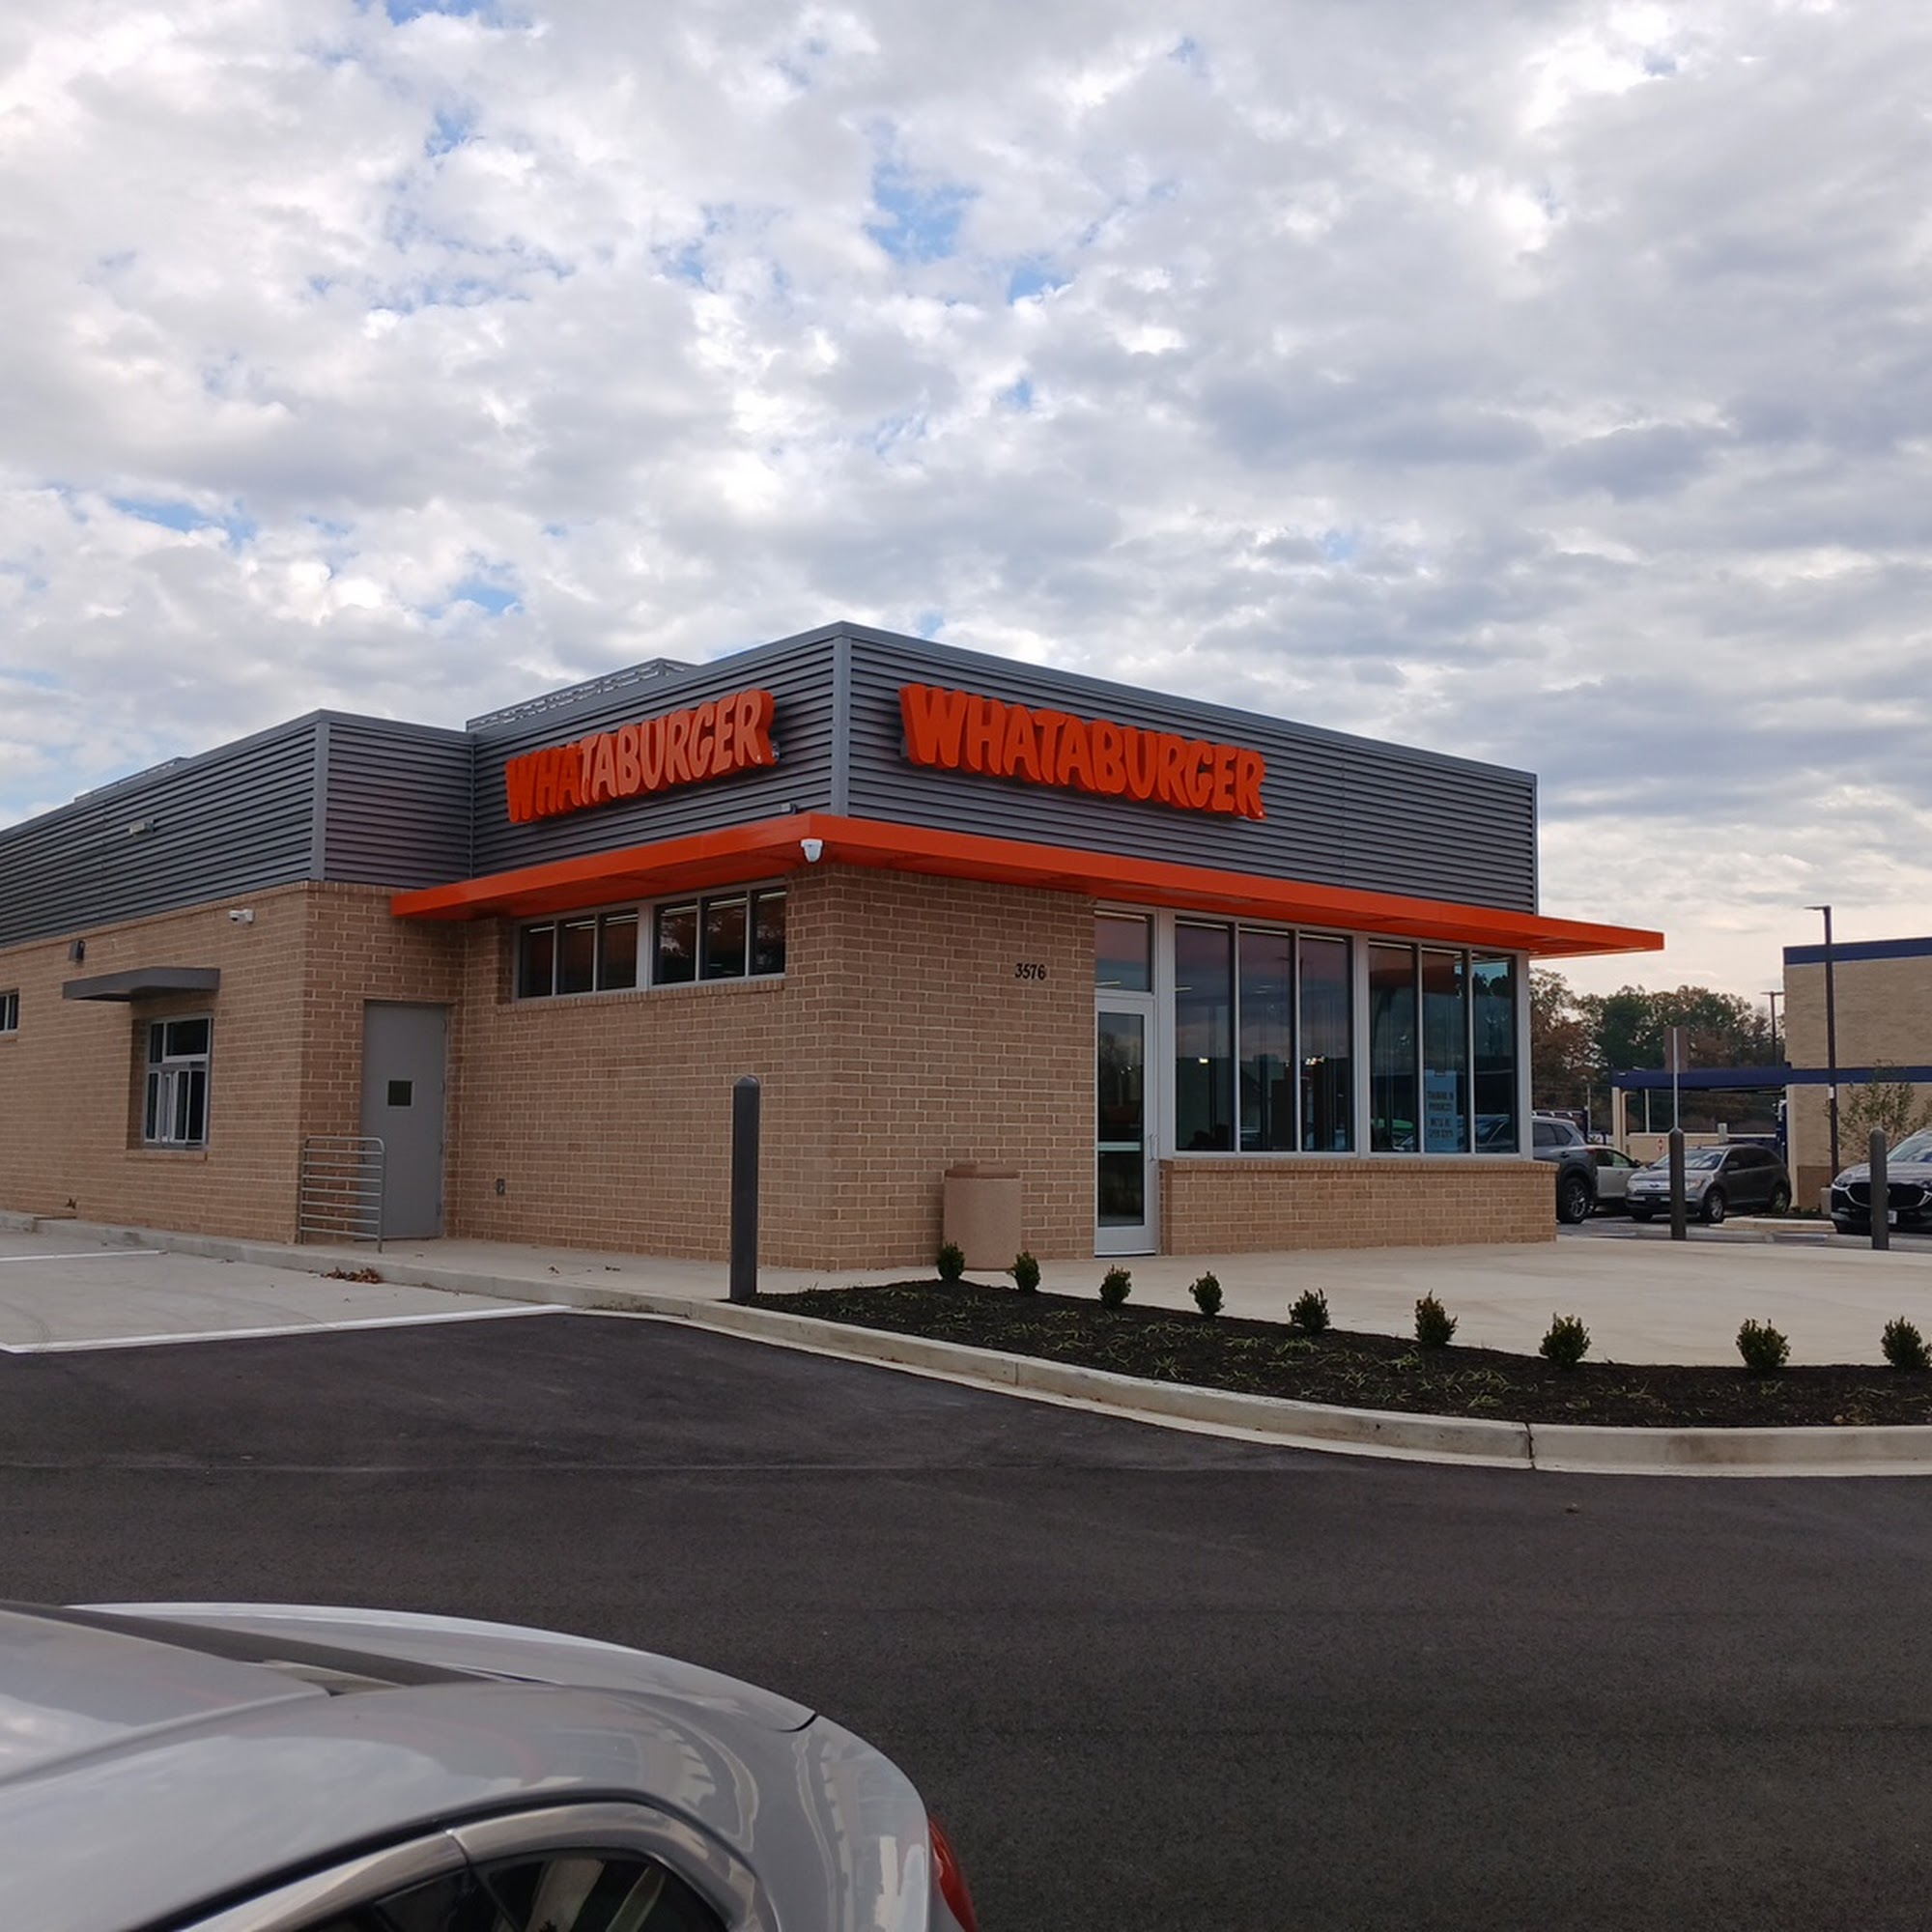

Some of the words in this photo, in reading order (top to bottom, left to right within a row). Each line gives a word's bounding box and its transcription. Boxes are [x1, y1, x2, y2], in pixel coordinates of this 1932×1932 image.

[505, 687, 776, 823] WHATABURGER
[899, 682, 1266, 820] WHATABURGER
[1014, 962, 1047, 981] 3576
